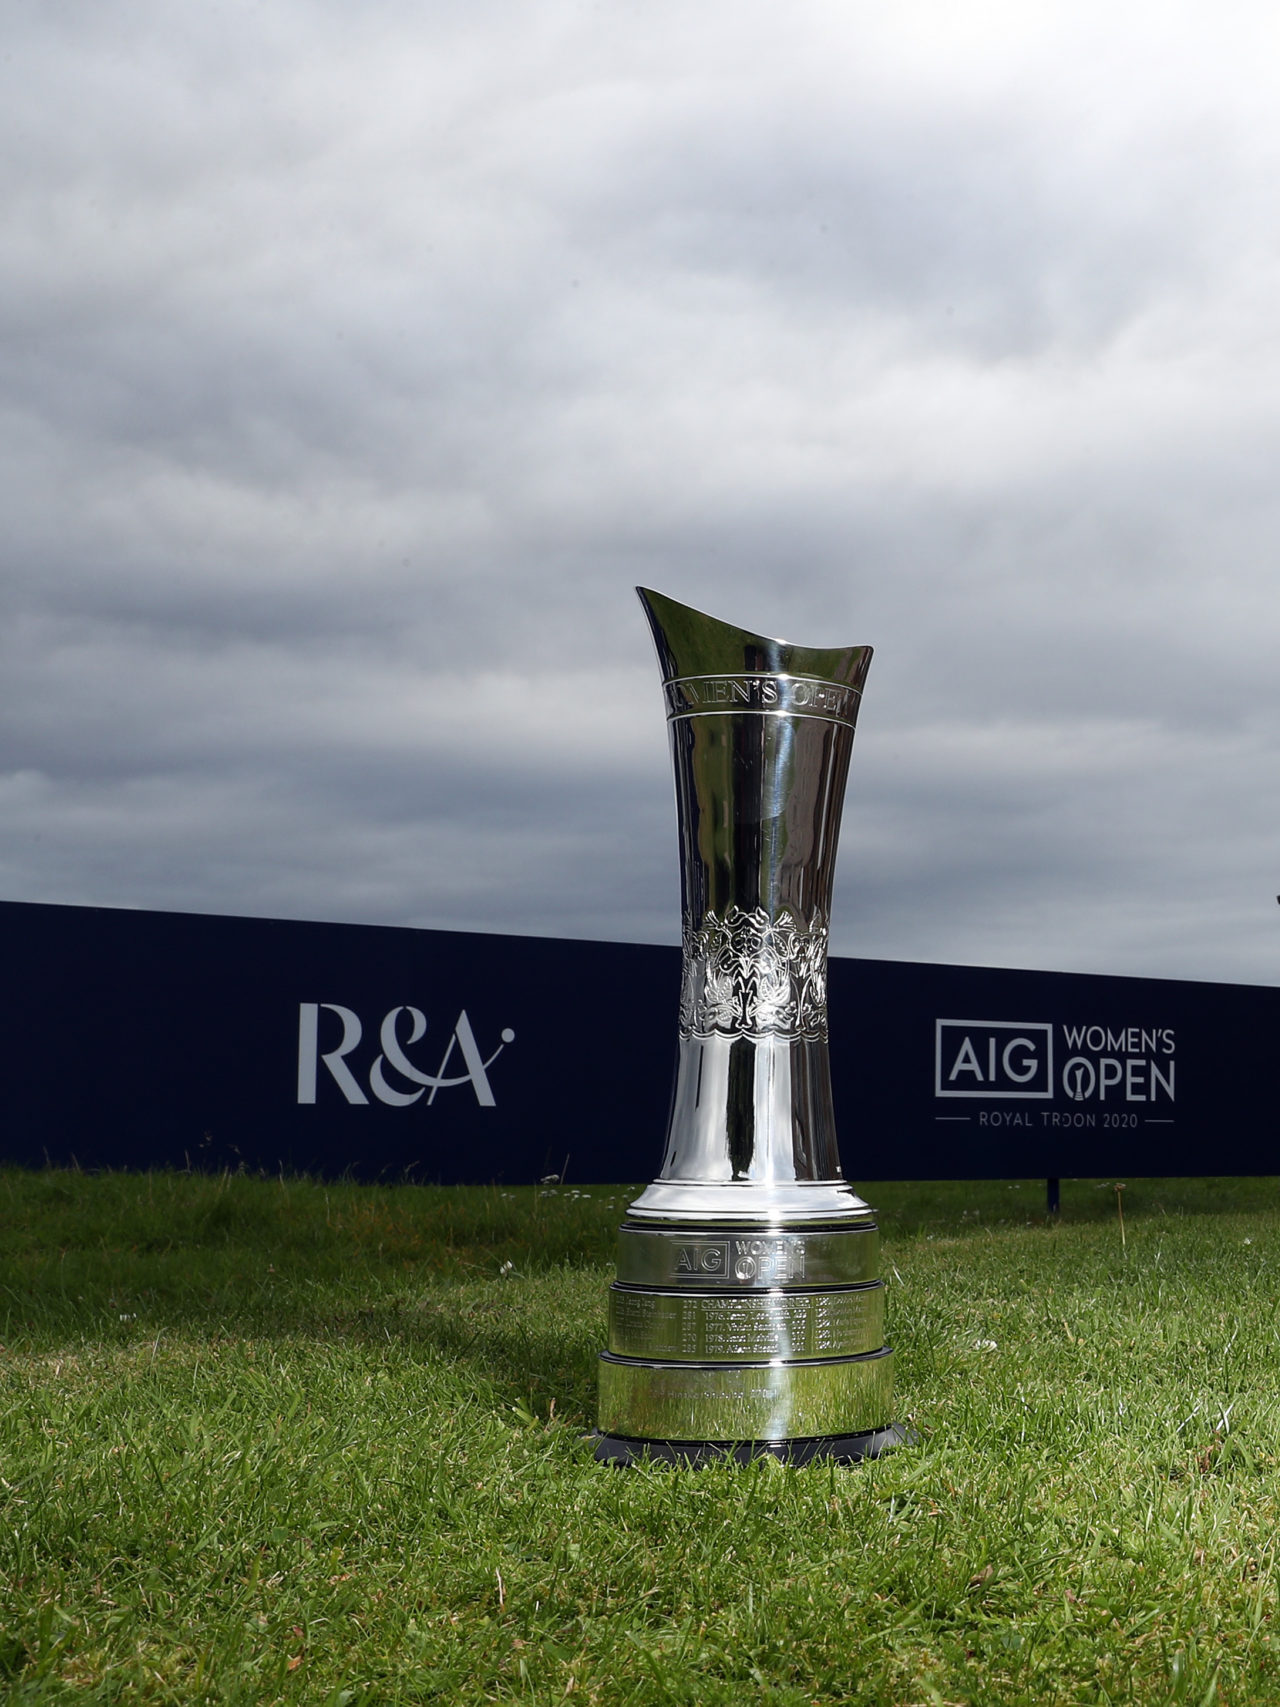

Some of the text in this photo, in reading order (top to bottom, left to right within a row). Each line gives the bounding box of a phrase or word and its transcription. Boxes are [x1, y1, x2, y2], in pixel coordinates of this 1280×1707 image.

[672, 680, 778, 707] OMEN'S
[1062, 1024, 1176, 1054] WOMEN'S
[297, 1002, 515, 1107] R&A
[948, 1036, 1039, 1083] AIG
[1062, 1056, 1176, 1102] OPEN
[979, 1111, 1138, 1128] ROYAL TROON 2020
[674, 1247, 722, 1272] AIG
[734, 1256, 806, 1280] OPEN
